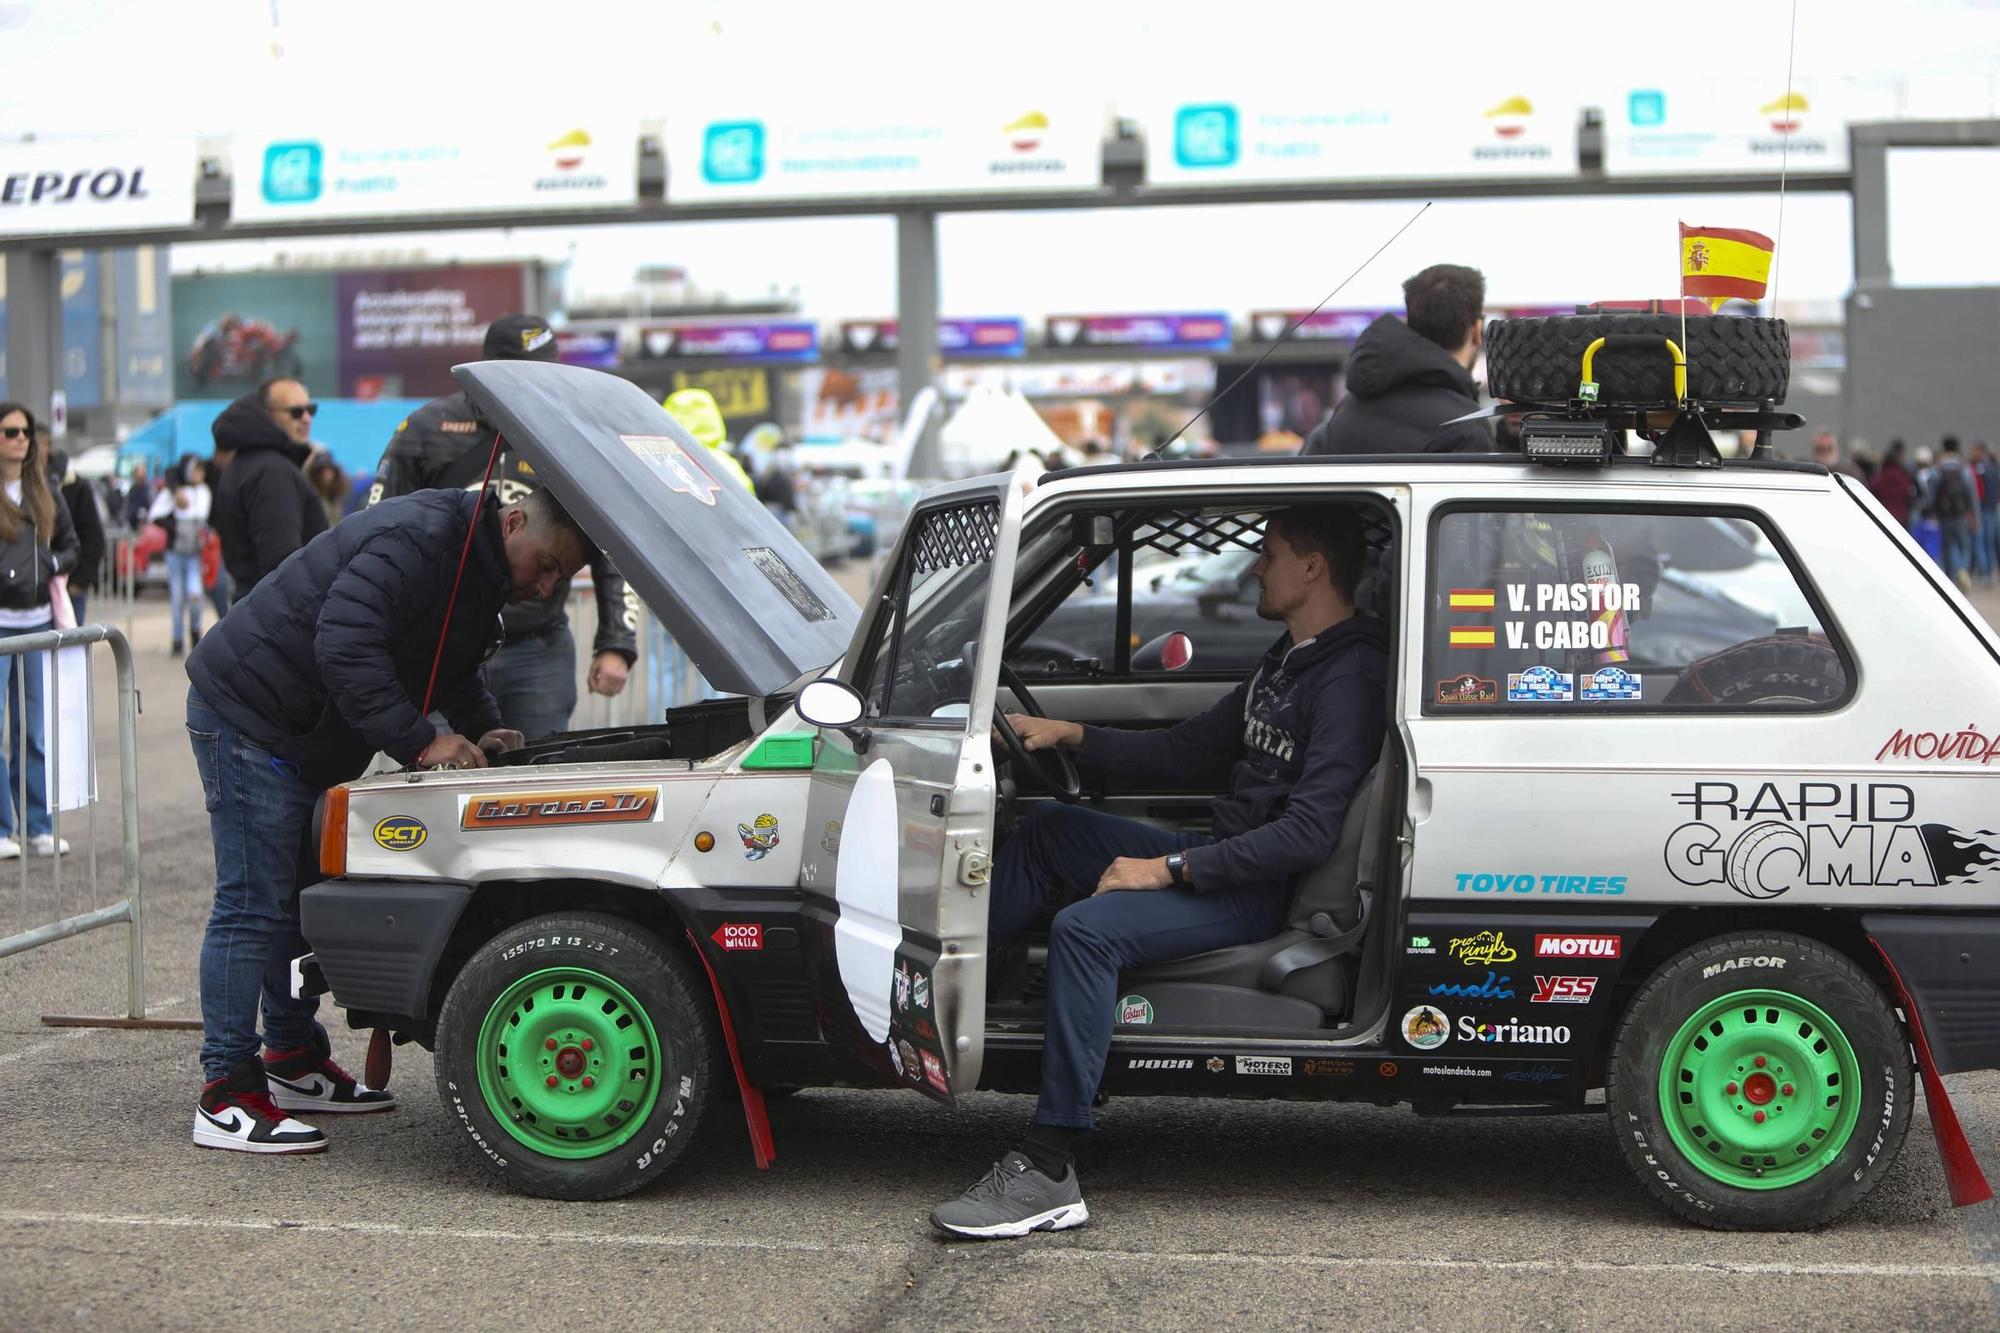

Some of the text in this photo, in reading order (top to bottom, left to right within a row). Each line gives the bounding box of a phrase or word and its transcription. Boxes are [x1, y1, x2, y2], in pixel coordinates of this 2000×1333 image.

[1507, 583, 1640, 611] V. PASTOR
[1505, 620, 1609, 649] V. CABO
[475, 799, 606, 819] Garage
[1671, 782, 1915, 822] RAPID
[379, 826, 422, 840] SCT
[1664, 820, 1938, 899] GOMA
[1455, 873, 1628, 895] TOYO TIRES
[724, 926, 758, 937] 1000
[725, 938, 759, 948] MIGLIA
[1539, 938, 1616, 956] MOTUL
[1703, 956, 1787, 979] MABOR
[1123, 1004, 1147, 1024] Castrol
[1457, 1015, 1571, 1044] Soriano
[1128, 1059, 1195, 1069] VOCA
